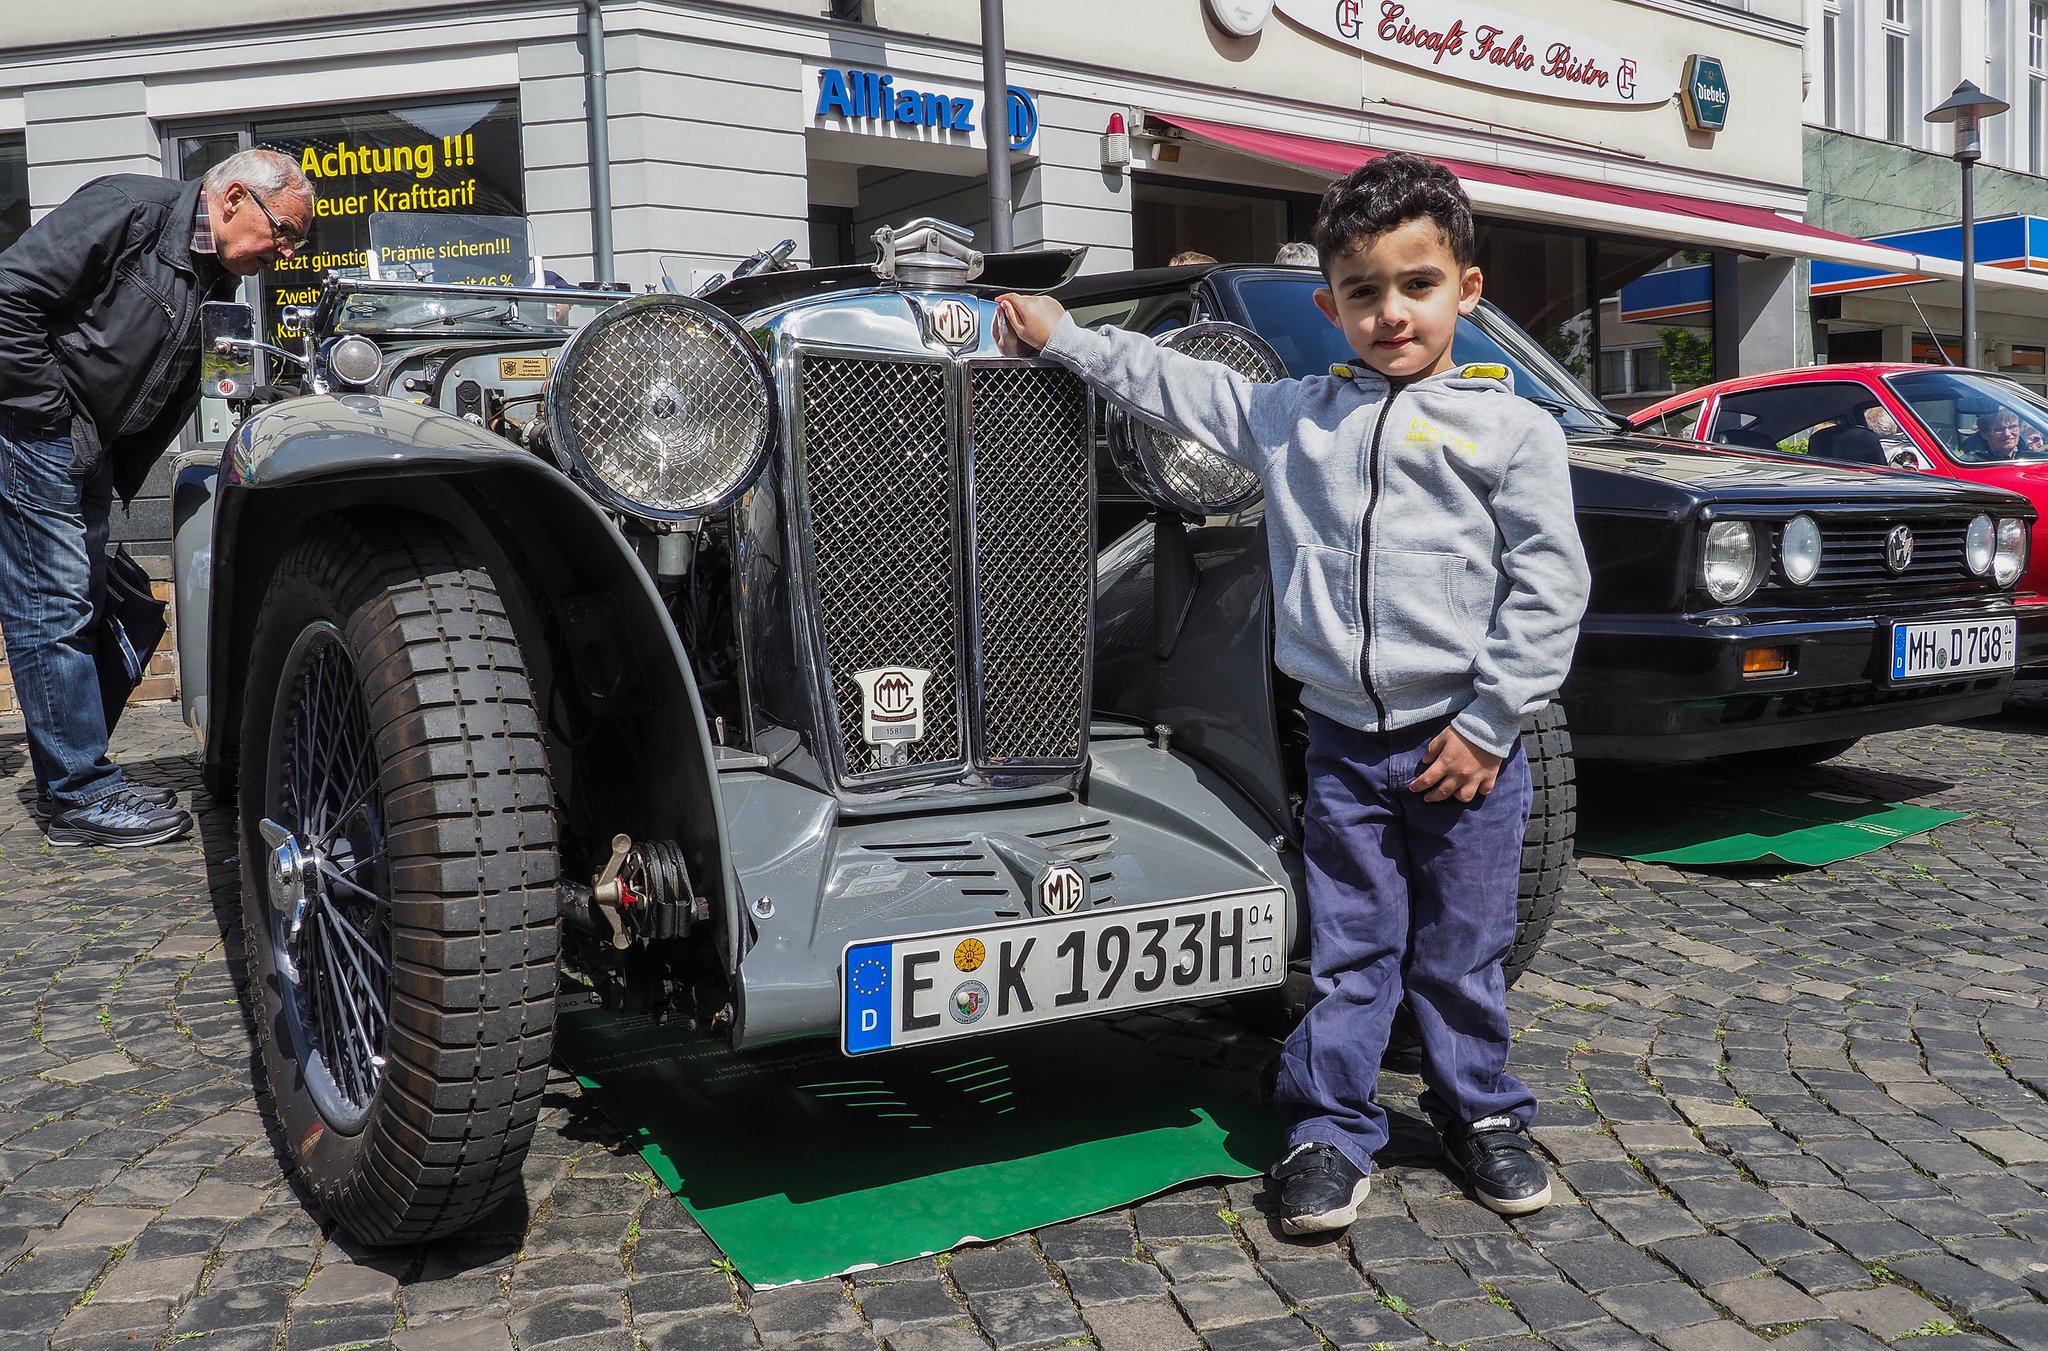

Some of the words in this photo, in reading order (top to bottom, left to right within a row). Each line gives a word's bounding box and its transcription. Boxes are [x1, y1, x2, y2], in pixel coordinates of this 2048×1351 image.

[1378, 1, 1468, 64] Eiscafé
[1470, 24, 1535, 72] Fabio
[1541, 42, 1609, 89] Bistro
[816, 68, 975, 133] Allianz
[1696, 81, 1726, 104] Diebels
[301, 141, 434, 179] Achtung
[311, 194, 368, 218] euer
[373, 178, 476, 212] Krafttarif
[381, 243, 435, 262] Prämie
[439, 237, 512, 259] sichern!!!
[938, 303, 971, 339] MG
[1897, 656, 1903, 669] D
[1908, 630, 1937, 671] MH
[1950, 628, 1963, 667] D
[1047, 871, 1083, 914] MG
[1248, 903, 1274, 926] 04
[901, 950, 941, 1032] E
[997, 937, 1037, 1015] K
[1054, 907, 1244, 1006] 1933H
[1249, 953, 1273, 976] 10
[860, 1008, 878, 1032] D
